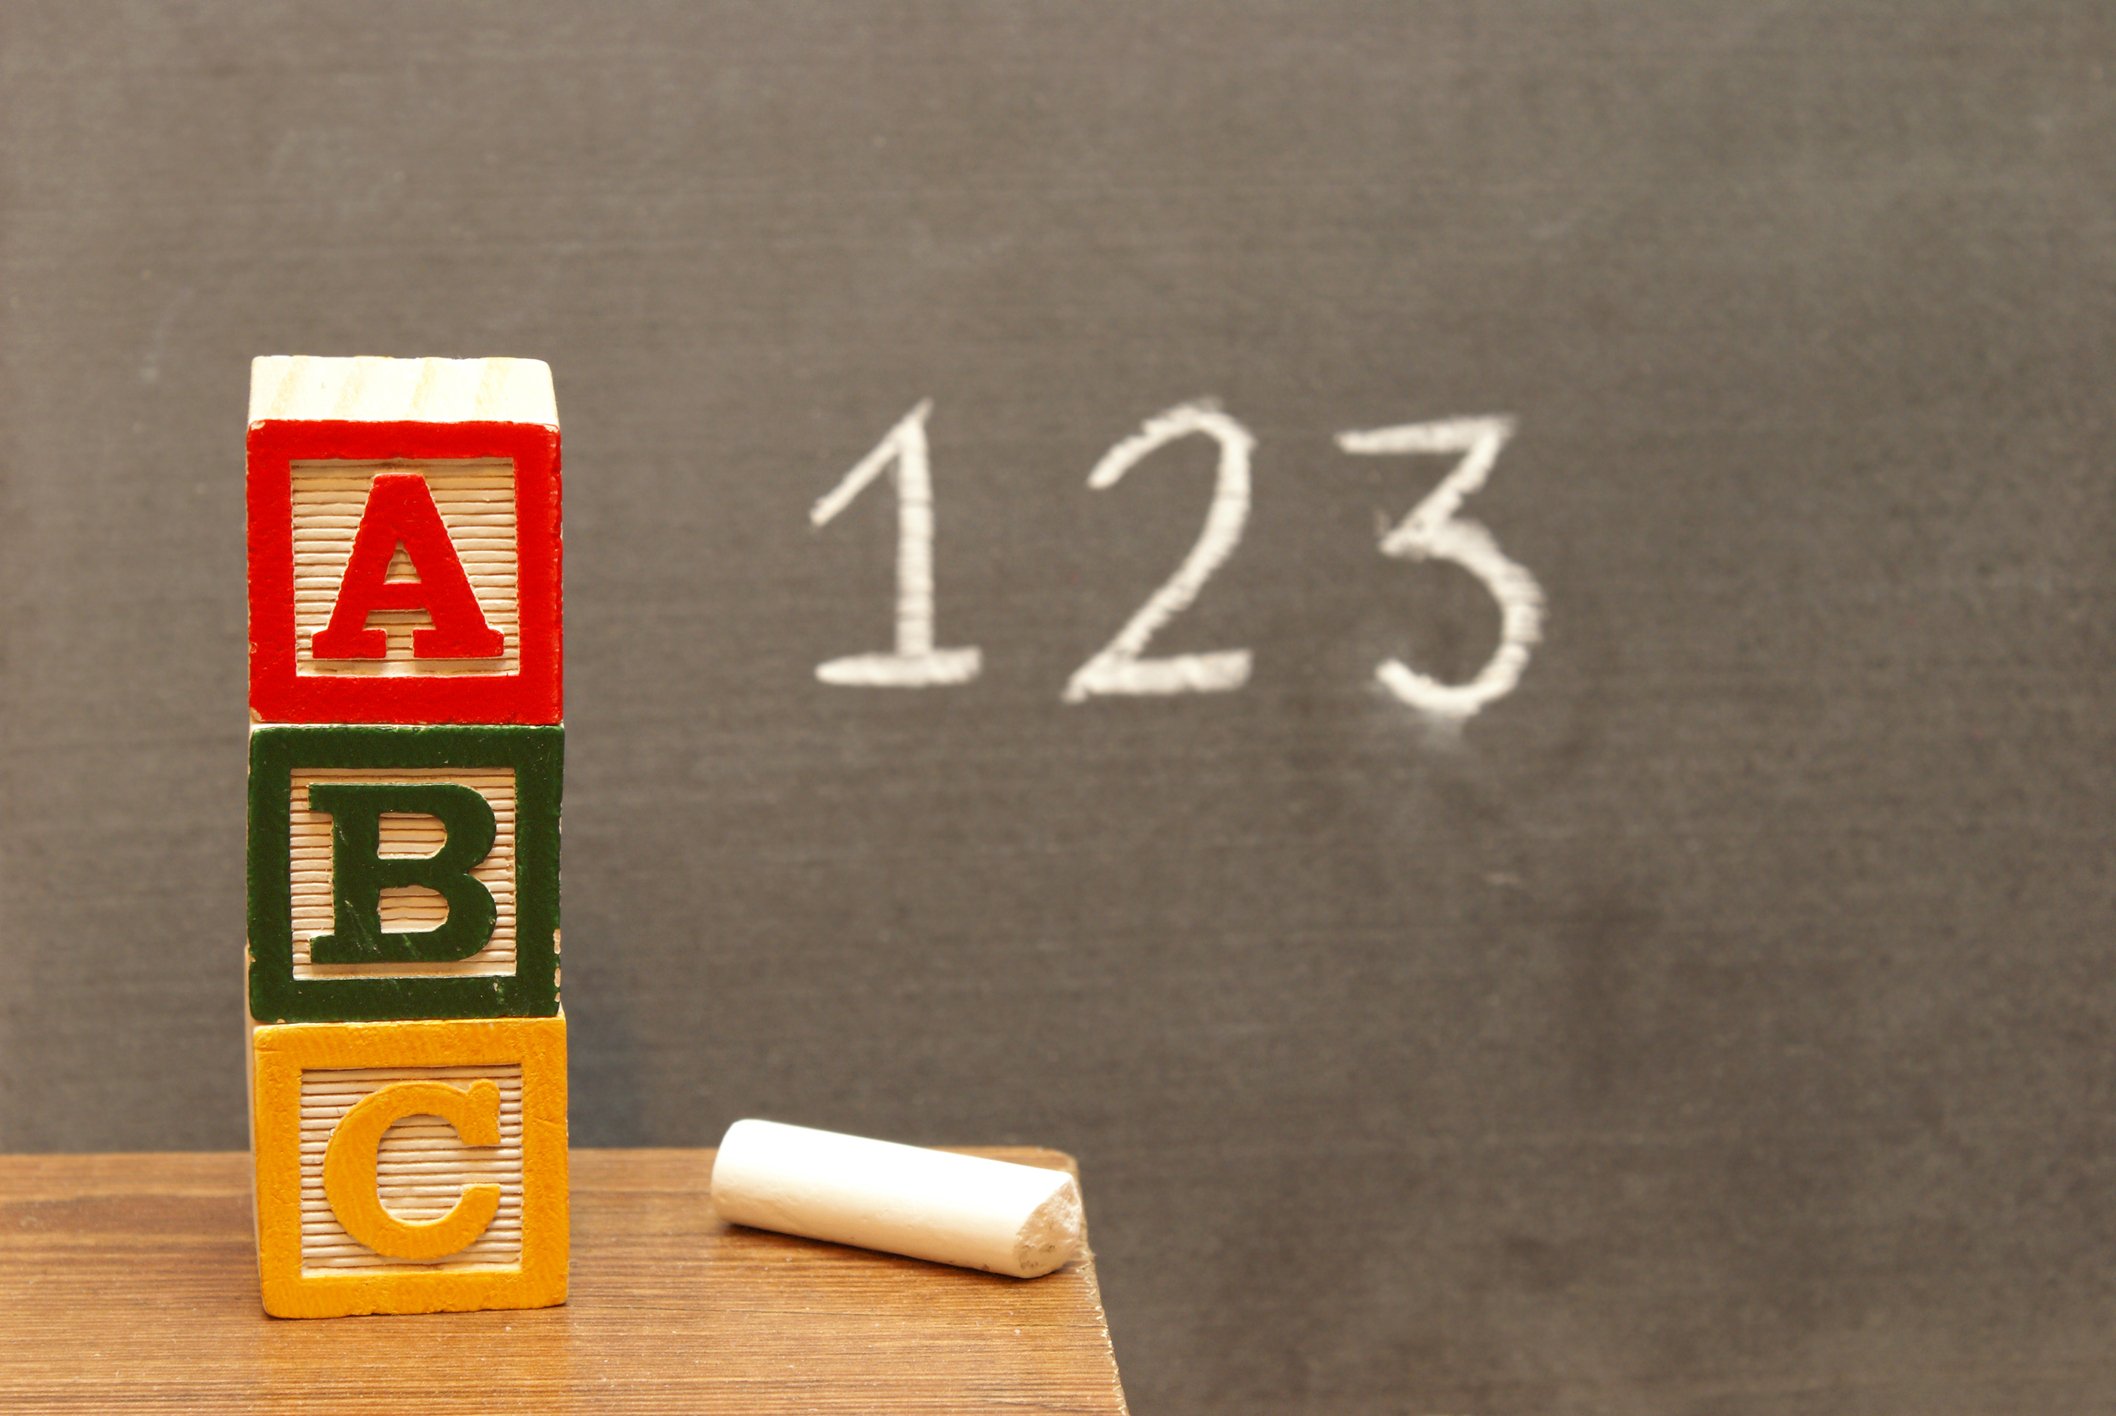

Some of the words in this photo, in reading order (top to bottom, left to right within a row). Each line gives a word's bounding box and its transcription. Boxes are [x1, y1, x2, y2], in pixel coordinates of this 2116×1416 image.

[312, 473, 504, 659] A
[309, 783, 497, 964] B
[323, 1079, 500, 1259] C
